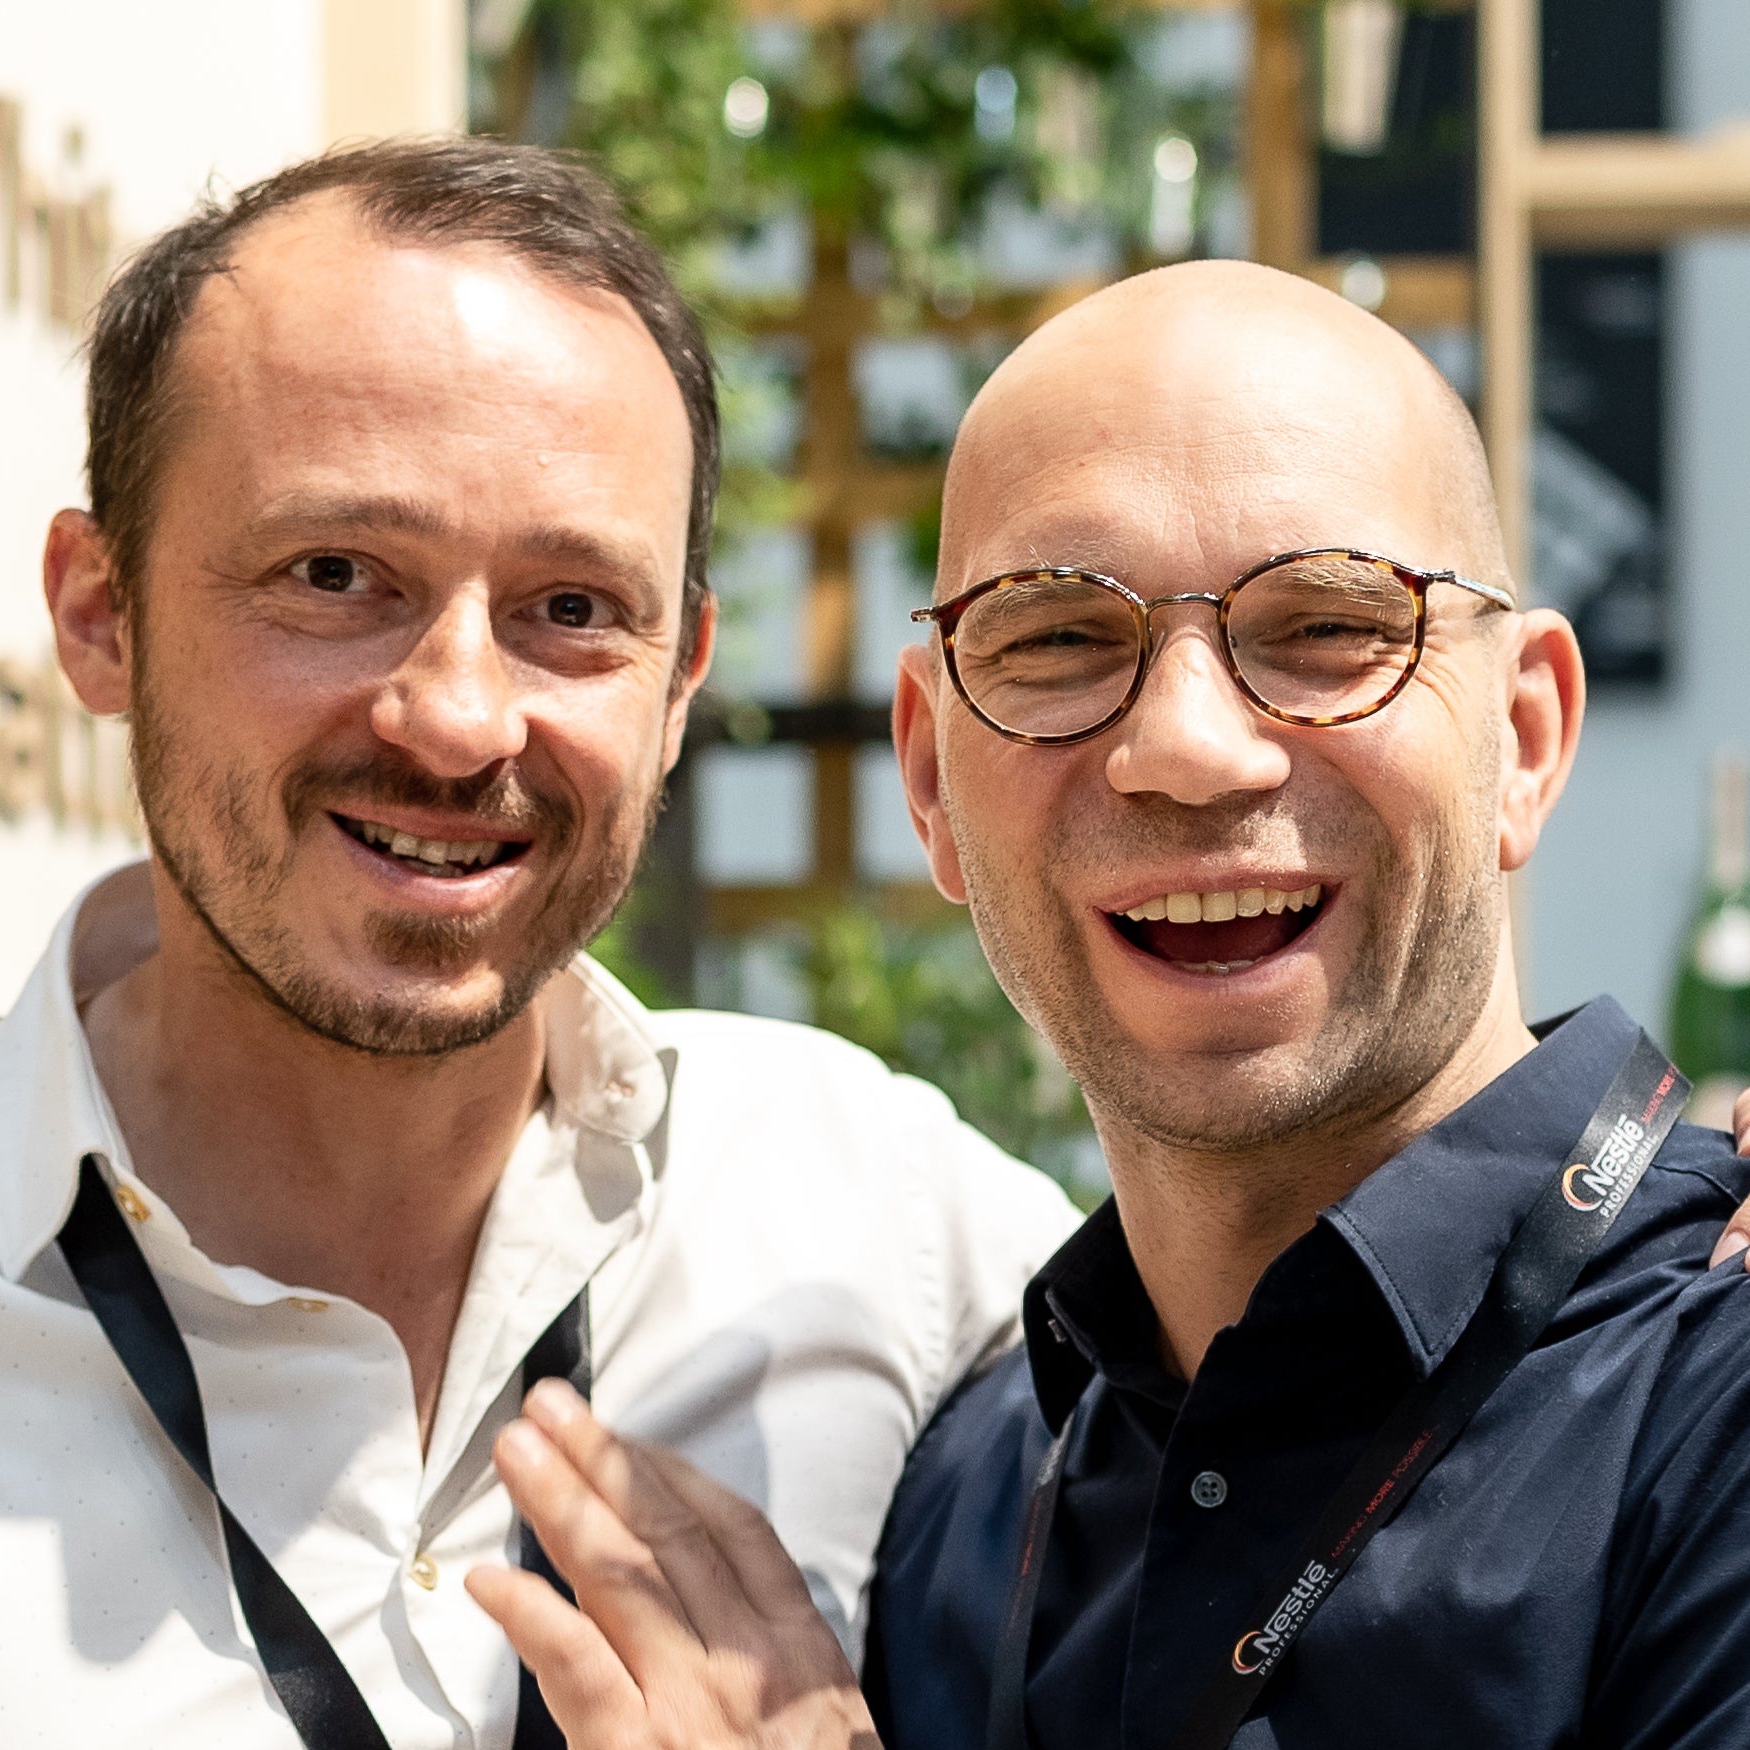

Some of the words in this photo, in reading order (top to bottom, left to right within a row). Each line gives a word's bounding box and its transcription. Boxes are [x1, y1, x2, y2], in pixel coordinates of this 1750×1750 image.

[1581, 1113, 1645, 1197] Nestlé
[1365, 1479, 1395, 1513] MORE
[1253, 1560, 1327, 1655] Nestlé
